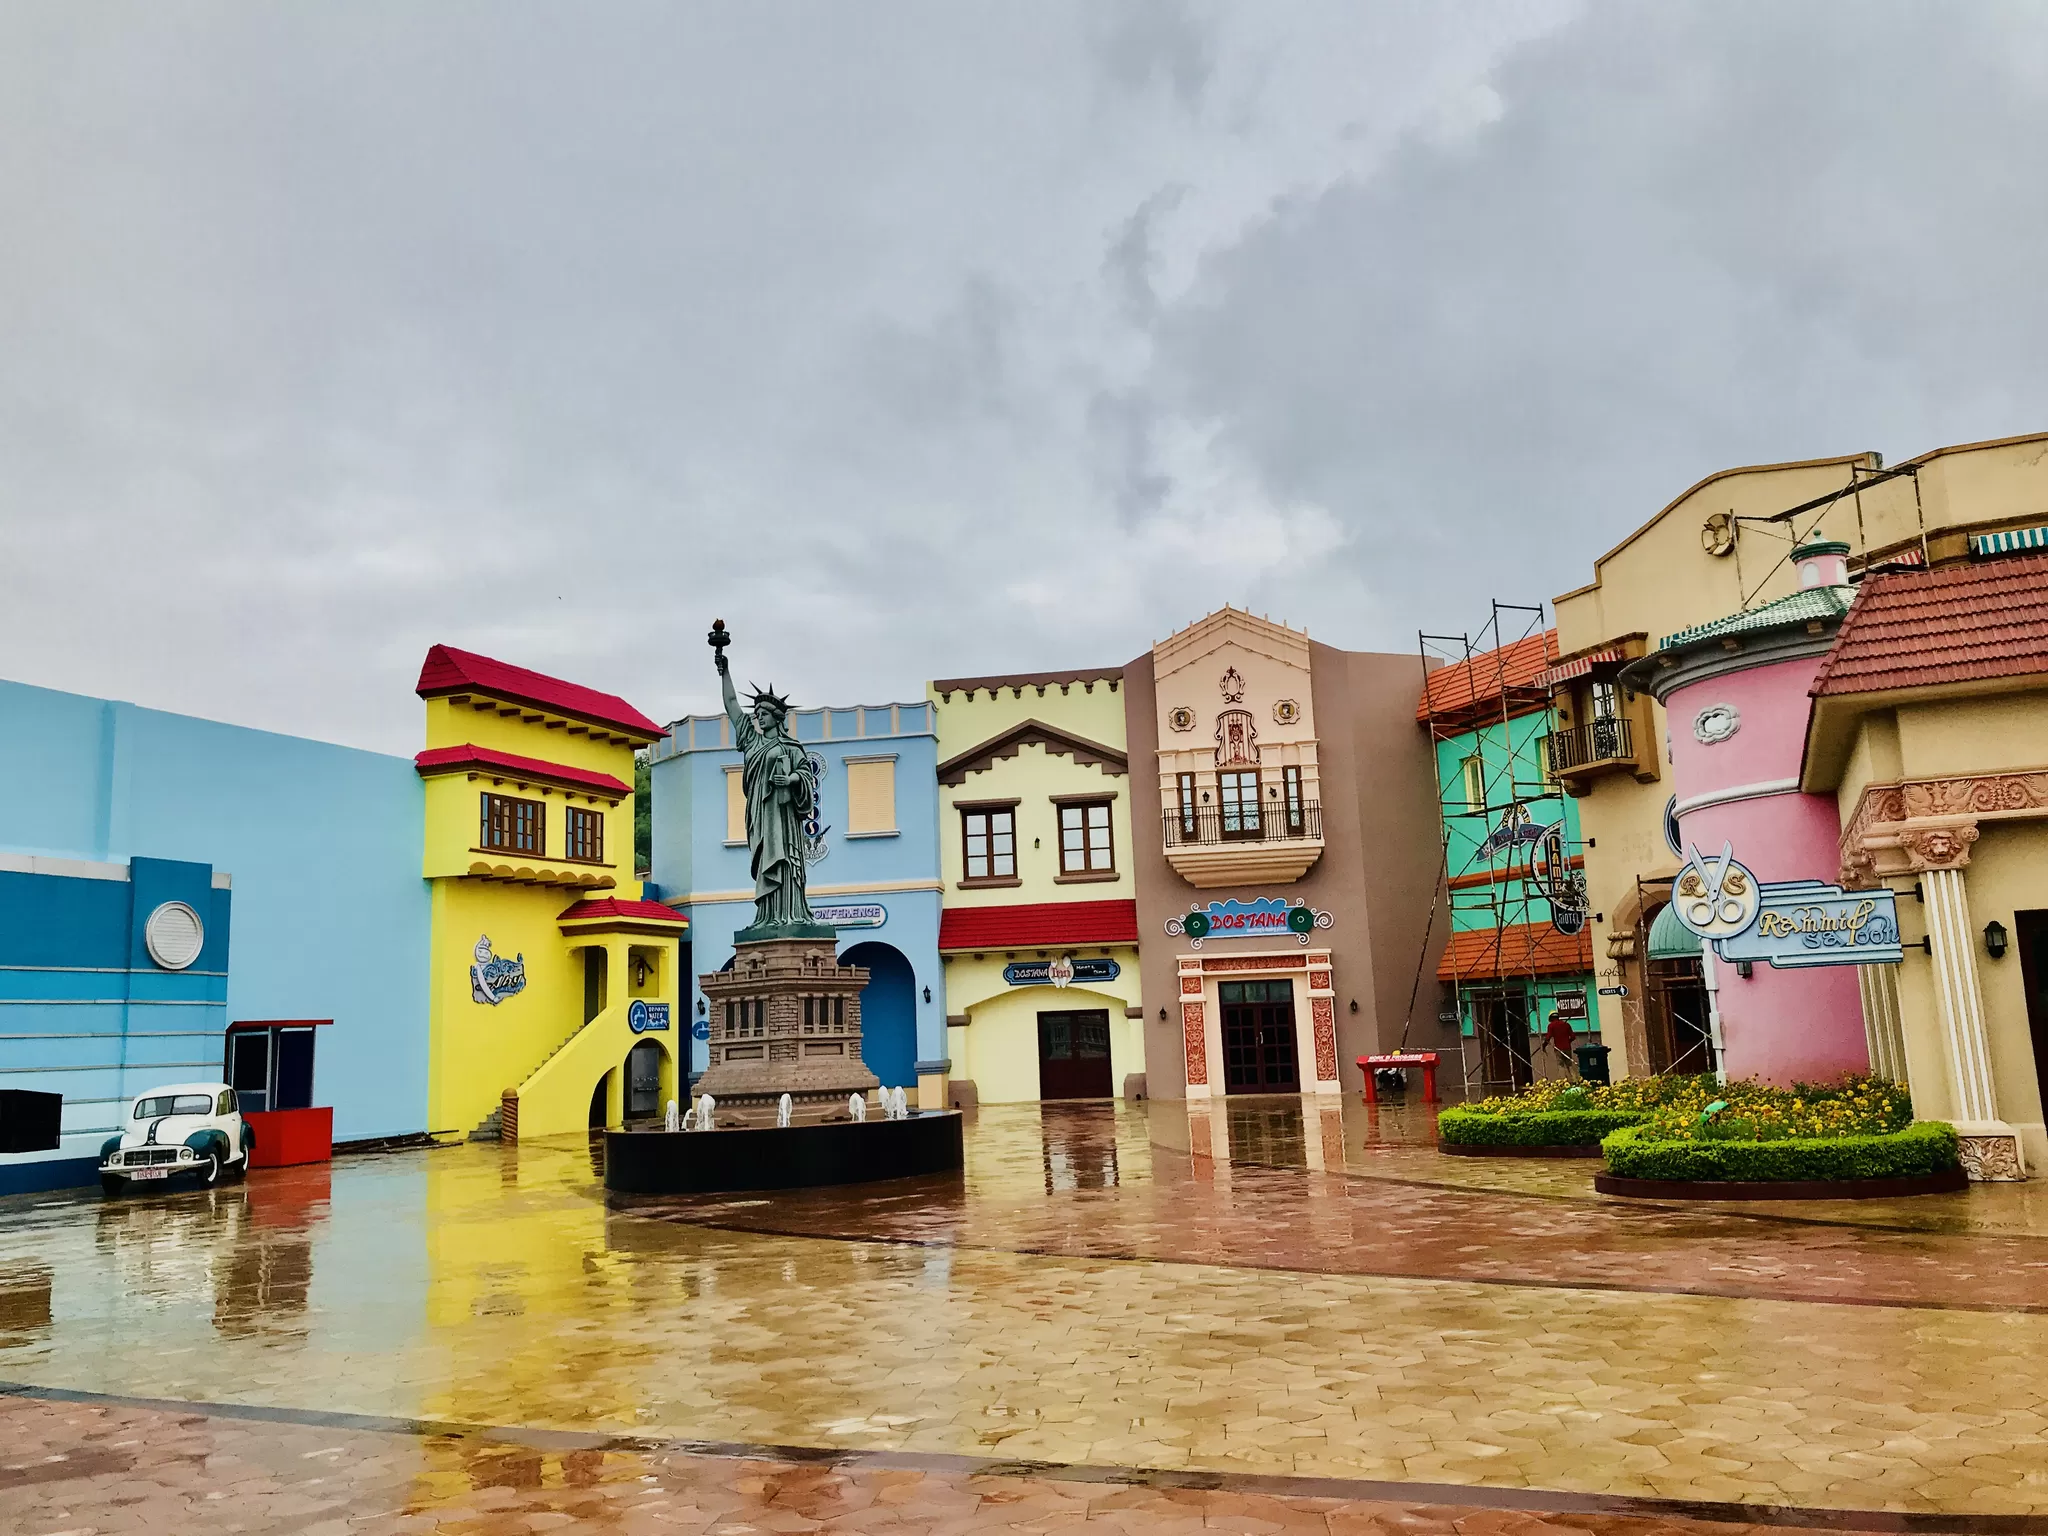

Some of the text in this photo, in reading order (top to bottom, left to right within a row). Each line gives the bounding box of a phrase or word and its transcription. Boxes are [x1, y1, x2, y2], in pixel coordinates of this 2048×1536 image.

[814, 907, 880, 919] ONFERENCE
[1211, 911, 1287, 930] DOSTANA
[1014, 968, 1071, 979] DOSTANA Inn
[1560, 998, 1581, 1010] REST ROOM
